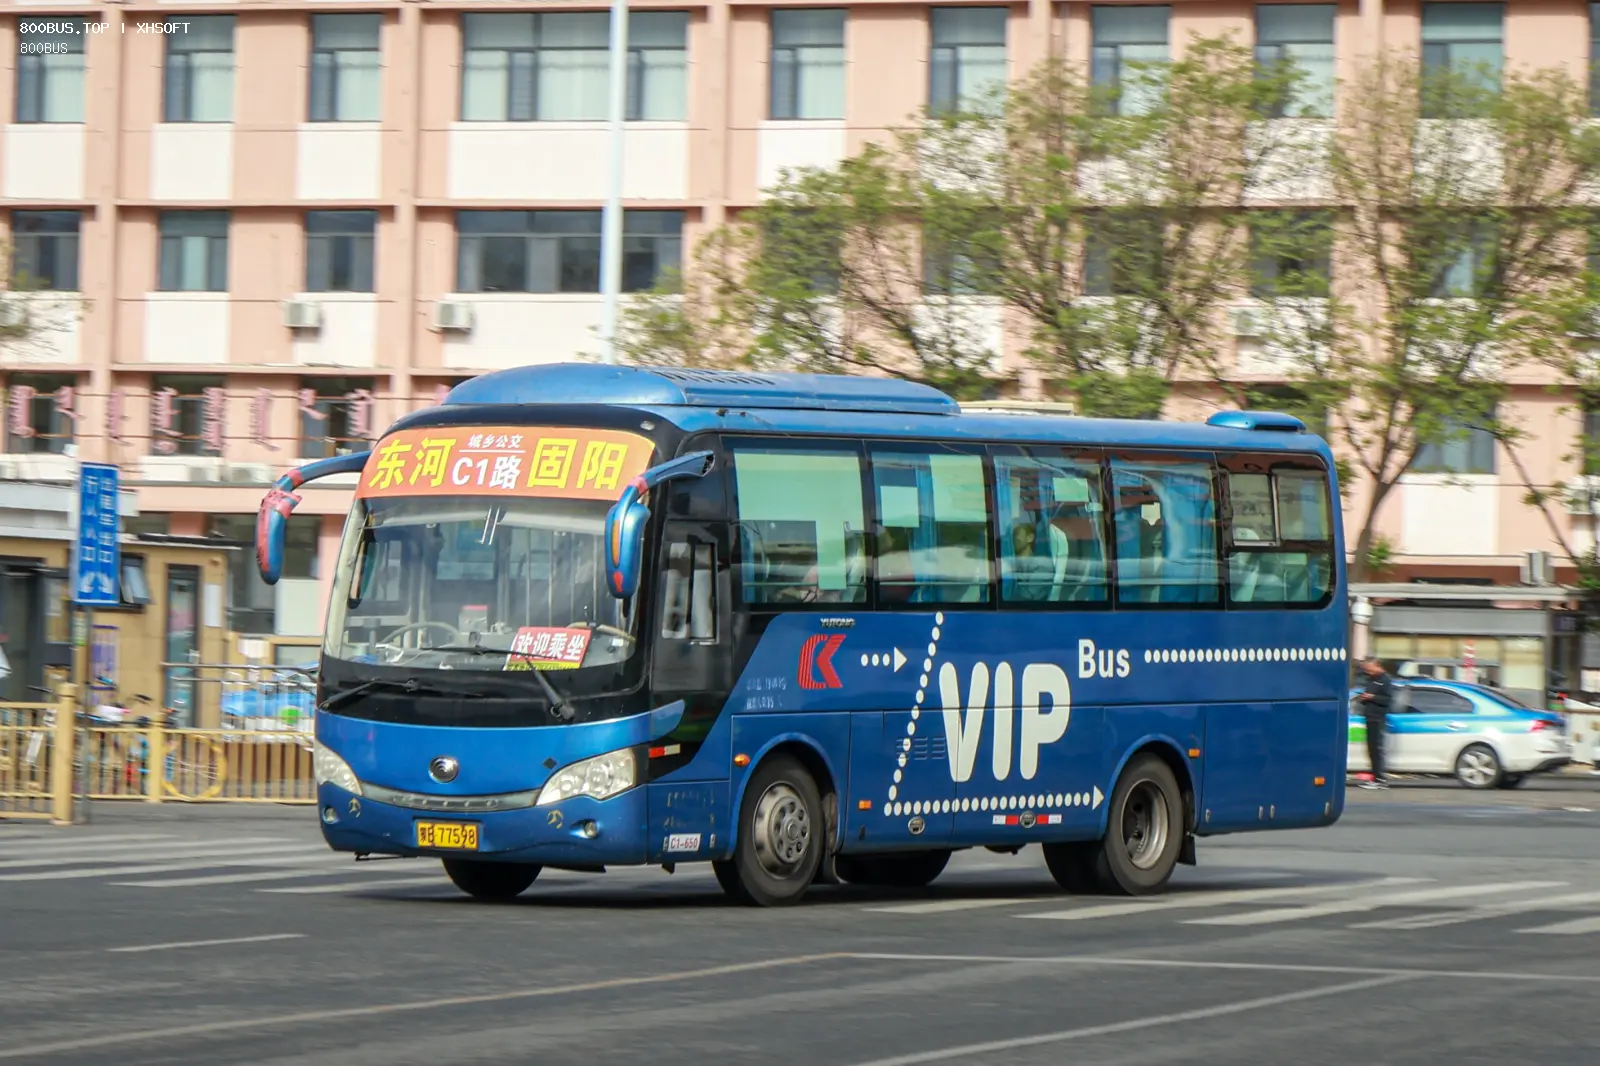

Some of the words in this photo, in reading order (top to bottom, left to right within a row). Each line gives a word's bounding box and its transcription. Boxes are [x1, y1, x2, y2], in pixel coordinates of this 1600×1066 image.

[368, 437, 456, 490] 东河
[452, 456, 521, 489] C1路
[526, 437, 628, 490] 固阳
[516, 631, 585, 660] 欢迎乘坐
[1078, 638, 1131, 679] Bus
[939, 661, 1070, 782] VIP
